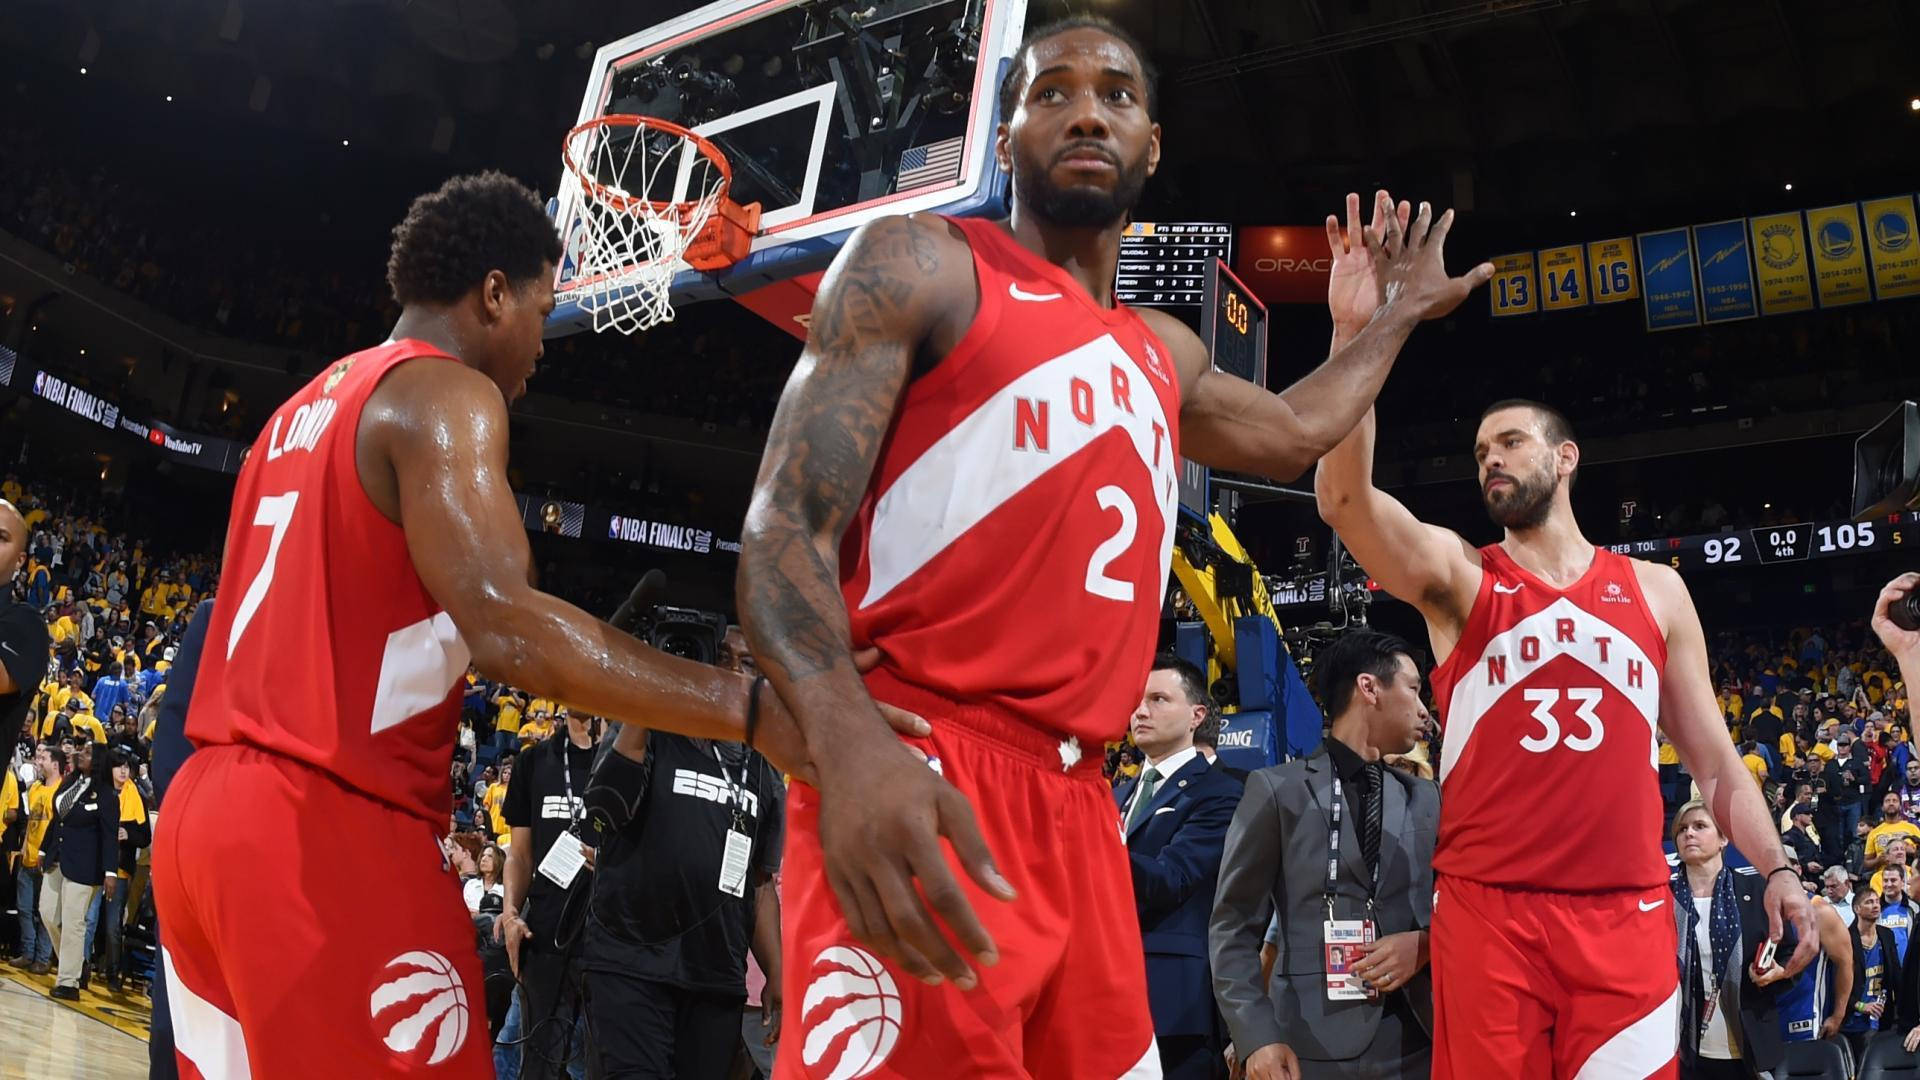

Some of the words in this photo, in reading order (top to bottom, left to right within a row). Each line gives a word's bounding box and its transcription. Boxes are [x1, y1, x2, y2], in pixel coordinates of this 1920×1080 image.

[1254, 257, 1332, 273] ORAC
[1598, 261, 1630, 295] 16
[1498, 275, 1529, 308] 13
[1548, 268, 1580, 302] 14
[1227, 290, 1248, 335] 0.0
[43, 374, 67, 407] NBA
[66, 385, 105, 424] FINALS
[102, 402, 120, 430] 2019
[620, 516, 647, 544] NBA
[649, 521, 695, 551] FINALS
[693, 529, 712, 554] 2019
[1084, 485, 1138, 602] 2
[1611, 543, 1631, 555] REB
[1637, 541, 1656, 553] TOL
[1703, 537, 1742, 564] 92
[1770, 529, 1797, 547] 0.0
[1775, 545, 1795, 557] 4th
[1817, 521, 1875, 552] 105
[1893, 531, 1902, 544] 5
[226, 490, 300, 662] 7
[1671, 556, 1681, 569] 5
[1272, 586, 1308, 605] INALS
[1308, 578, 1326, 603] 2019
[1487, 618, 1644, 689] NORTH
[1518, 688, 1605, 753] 33
[1217, 729, 1253, 747] DING
[672, 768, 759, 818] ESPN
